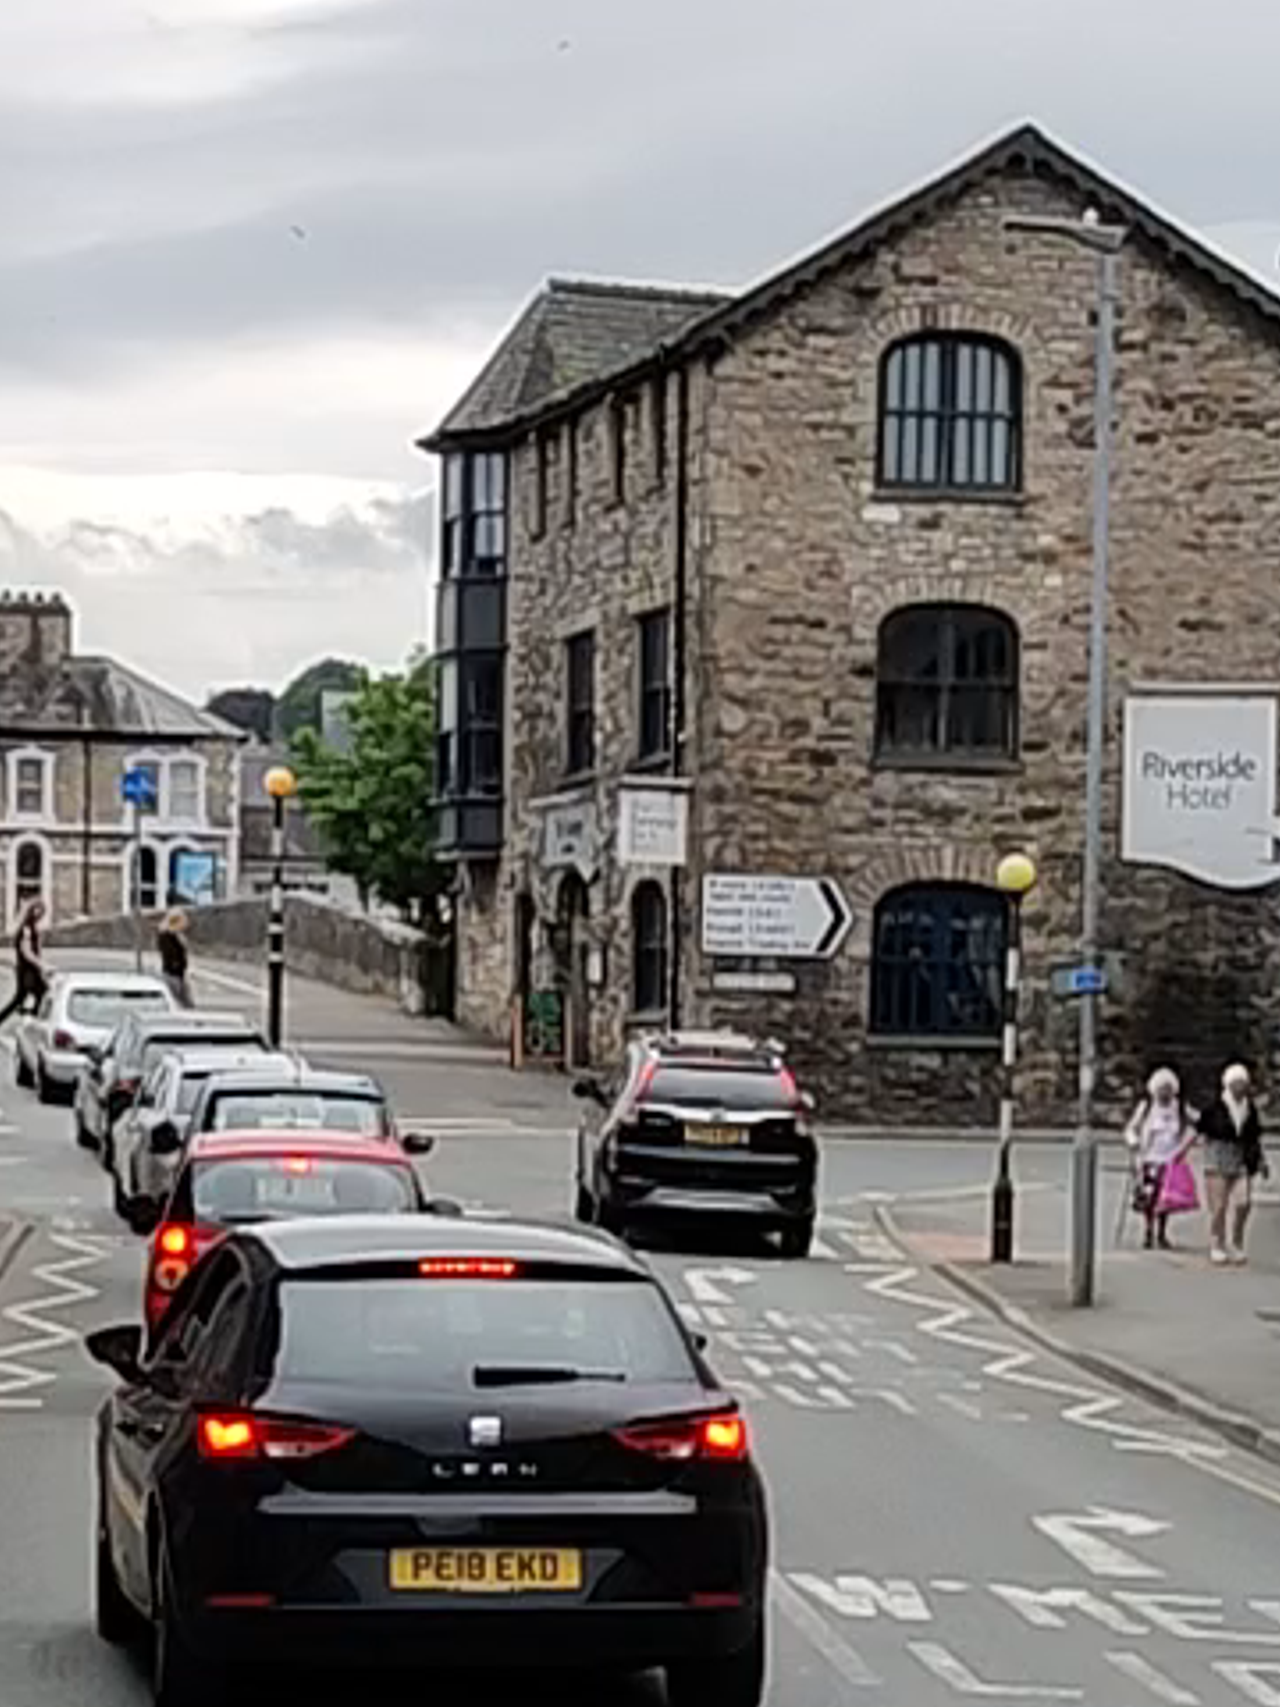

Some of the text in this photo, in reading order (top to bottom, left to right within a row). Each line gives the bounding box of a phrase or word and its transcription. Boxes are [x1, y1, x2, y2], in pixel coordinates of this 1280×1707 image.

[1142, 750, 1258, 782] Riverside
[1167, 782, 1232, 810] Hotel
[496, 1551, 559, 1582] EKD
